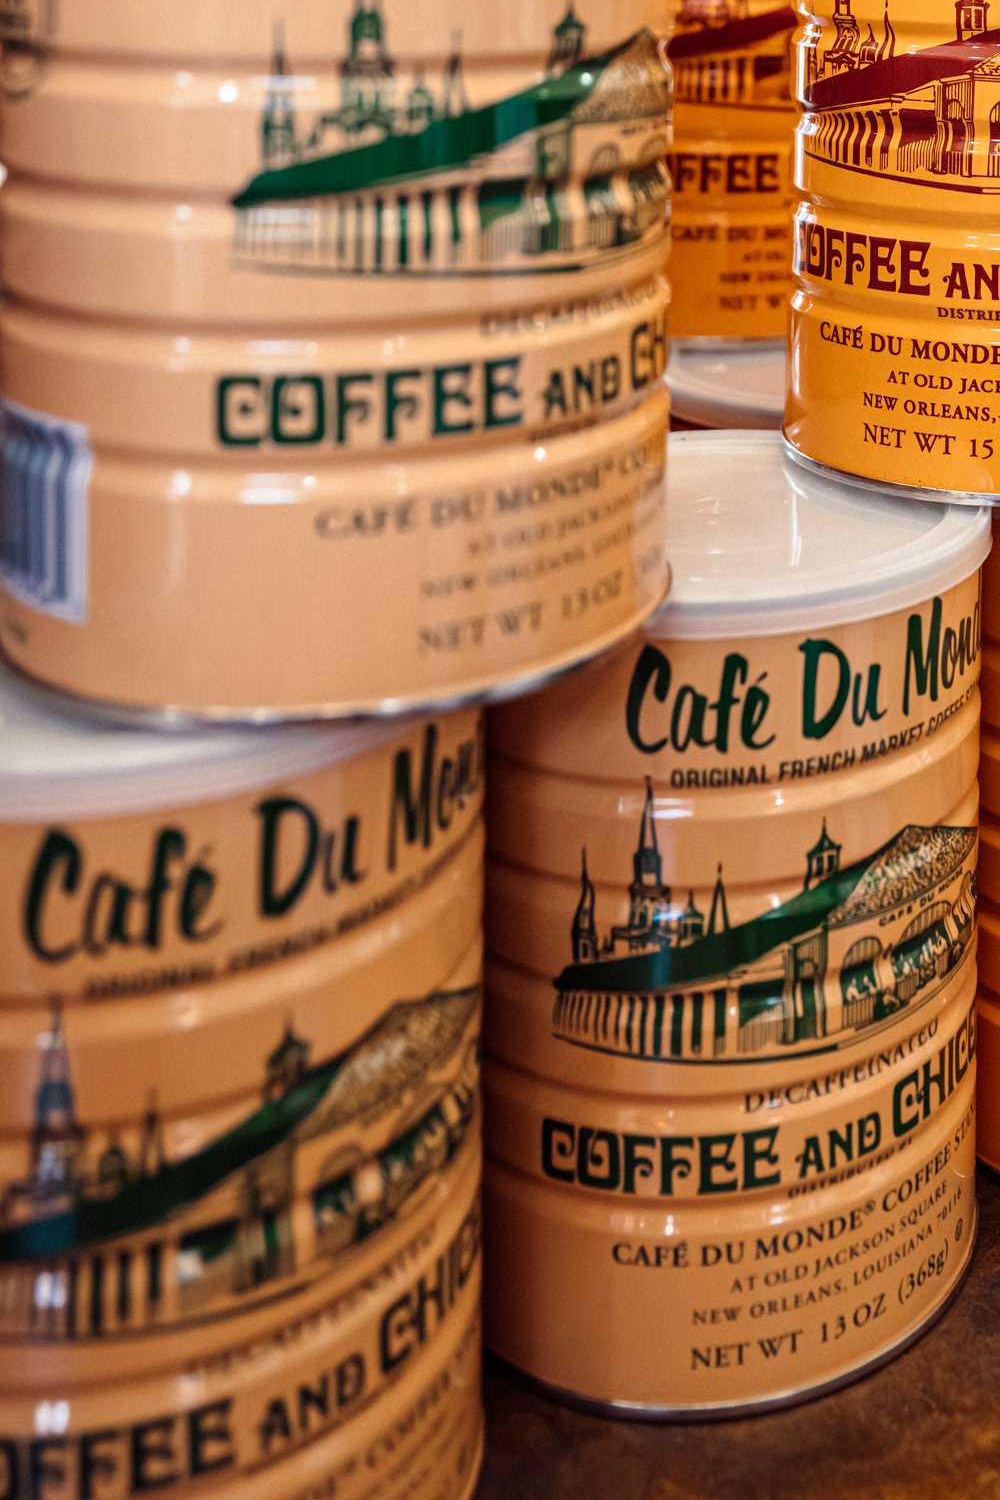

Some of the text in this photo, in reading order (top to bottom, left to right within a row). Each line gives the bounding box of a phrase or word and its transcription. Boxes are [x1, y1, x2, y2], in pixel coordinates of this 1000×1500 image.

[820, 321, 864, 350] CAFÉ
[870, 332, 903, 356] DU
[886, 371, 910, 385] AT
[914, 373, 953, 391] OLD
[215, 353, 621, 447] COFFEE AND
[862, 392, 899, 410] NEW
[903, 398, 996, 423] ORLEANS,
[863, 423, 907, 450] NET
[913, 432, 956, 455] WT
[969, 437, 994, 460] 15
[626, 643, 776, 754] Café
[799, 638, 887, 740] Du
[670, 768, 771, 790] ORIGINAL
[778, 749, 856, 782] FRENCH
[860, 721, 926, 764] MARKET
[23, 825, 224, 965] Café
[256, 791, 368, 920] Du
[744, 1018, 939, 1115] DECAFFEINATED
[542, 1118, 782, 1196] COFFEE
[795, 1111, 881, 1178] AND
[612, 1240, 689, 1269] CAFÉ
[701, 1241, 745, 1268] DU
[882, 1141, 951, 1214] COFFEE
[731, 1179, 947, 1294] AT OLD JACKSON SQUARE
[691, 1238, 950, 1372] NET WT 13 OZ (368g)
[692, 1307, 742, 1326] NEW
[853, 1223, 934, 1287] LOUISIANA
[260, 1351, 366, 1452] AND
